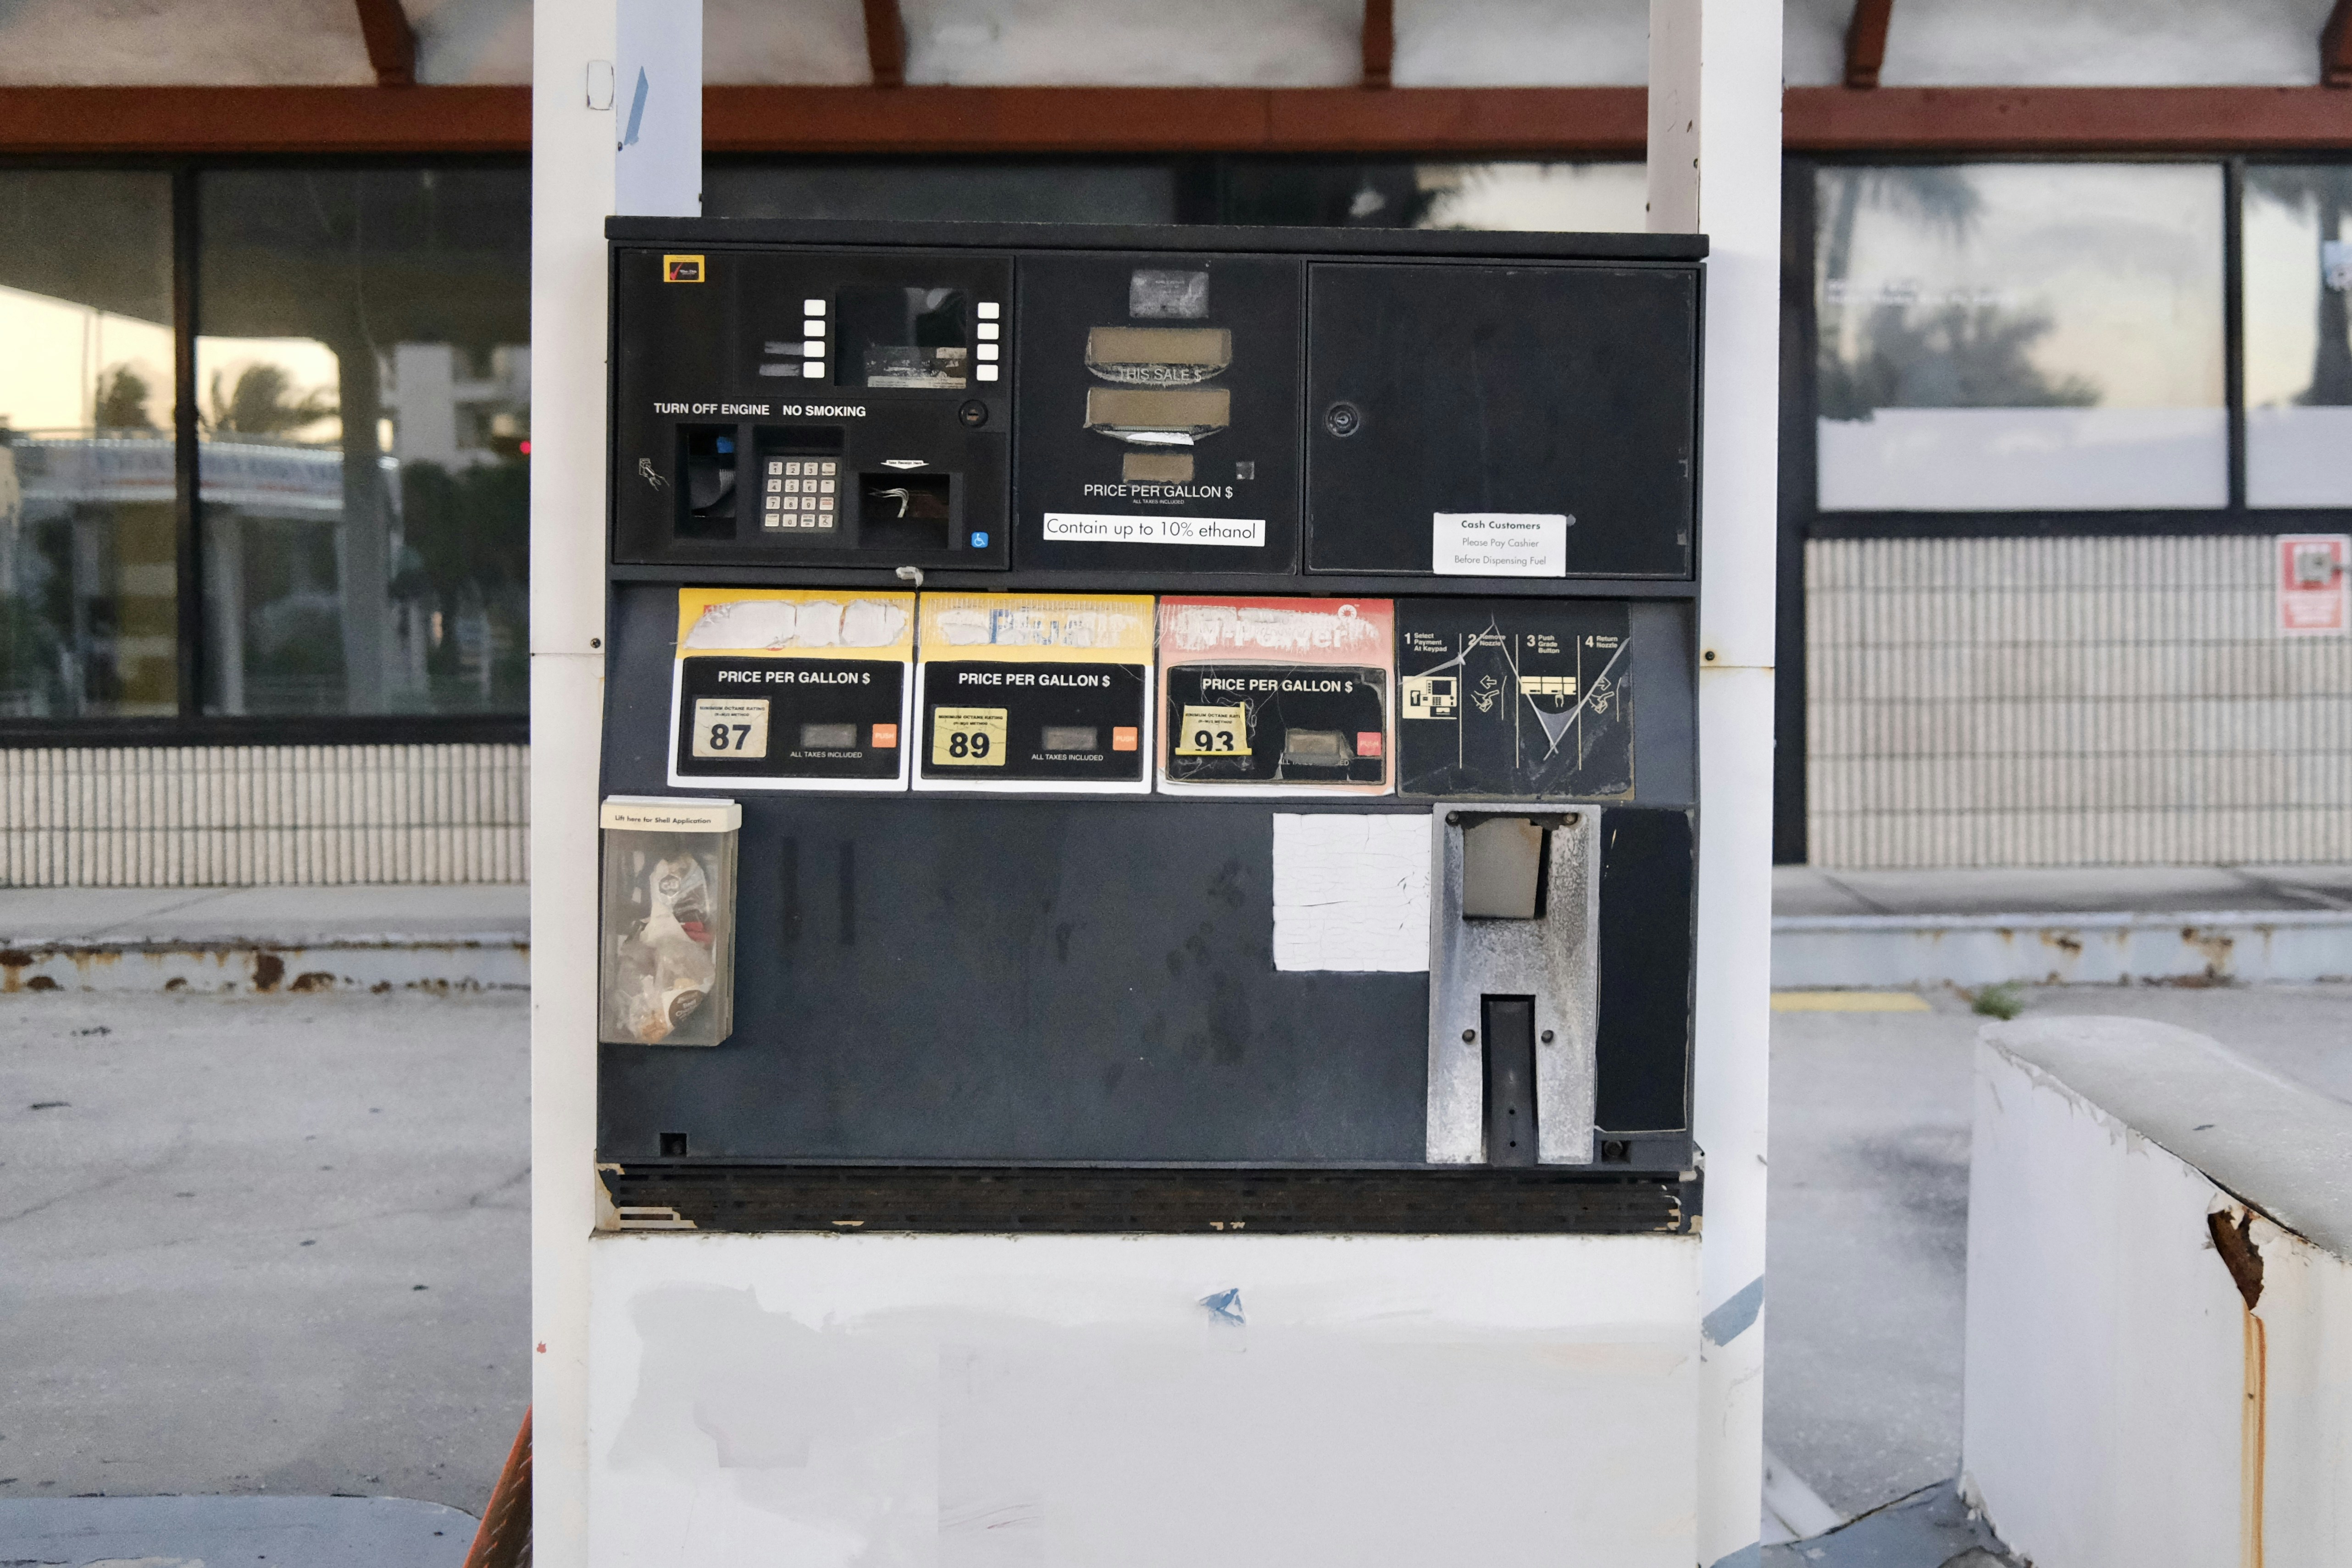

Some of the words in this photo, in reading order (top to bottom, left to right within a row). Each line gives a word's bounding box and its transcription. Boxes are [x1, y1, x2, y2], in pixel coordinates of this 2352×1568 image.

[1120, 367, 1149, 381] THIS
[1154, 368, 1189, 381] SALE
[1194, 369, 1202, 382] $
[654, 403, 689, 414] TURN
[692, 403, 718, 414] OFF
[721, 404, 770, 415] ENGINE
[783, 405, 802, 416] NO
[805, 405, 866, 417] SMOKING
[1084, 484, 1126, 496] PRICE
[1132, 485, 1160, 497] PER
[1164, 486, 1221, 498] GALLON
[1225, 486, 1233, 499] $
[1047, 519, 1107, 534] Contain
[1114, 524, 1133, 538] up
[1140, 523, 1153, 535] to
[1161, 521, 1193, 537] 10%
[1199, 522, 1255, 538] ethanol
[1489, 521, 1541, 530] Customers
[1463, 537, 1488, 546] Please
[1491, 538, 1505, 549] Pay
[1508, 538, 1539, 547] Cashier
[1455, 554, 1481, 564] Before
[1483, 556, 1527, 567] Dispensing
[1530, 556, 1546, 565] Fuel
[1404, 632, 1410, 644] 1
[1468, 634, 1477, 646] 2
[1526, 635, 1536, 647] 3
[1585, 635, 1594, 648] 4
[718, 671, 761, 682] PRICE
[766, 671, 794, 683] PER
[799, 672, 858, 684] GALLON
[862, 673, 871, 685] $
[959, 673, 1001, 685] PRICE
[1006, 674, 1035, 685] PER
[1038, 675, 1098, 687] GALLON
[1102, 675, 1110, 687] $
[1203, 679, 1245, 690] PRICE
[1250, 679, 1277, 691] PER
[1282, 680, 1341, 692] GALLON
[1345, 681, 1353, 693] $
[710, 724, 752, 750] 87
[1195, 730, 1234, 751] 93
[949, 732, 990, 758] 89
